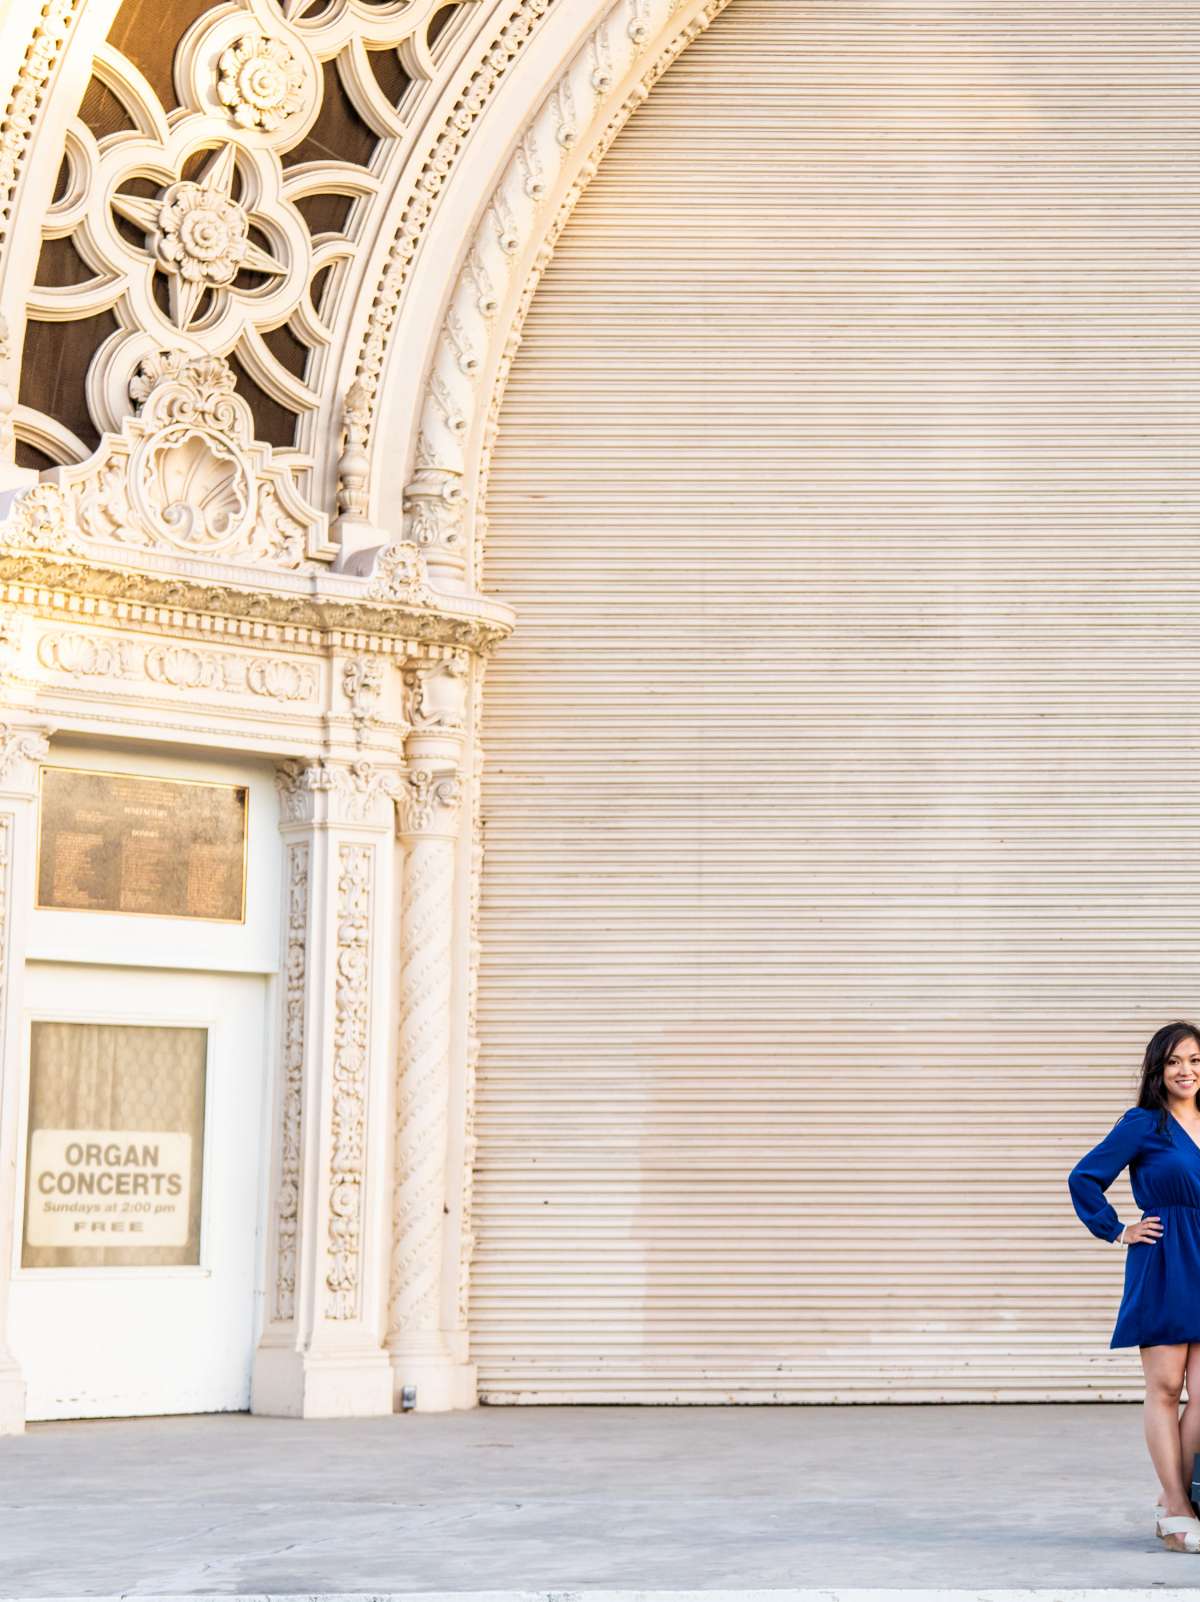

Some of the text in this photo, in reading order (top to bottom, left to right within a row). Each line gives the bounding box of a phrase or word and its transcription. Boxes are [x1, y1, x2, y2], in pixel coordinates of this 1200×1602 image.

[65, 1143, 160, 1168] ORGAN
[38, 1171, 182, 1196] CONCERTS
[43, 1200, 176, 1215] Sundays at 2:00 pm
[73, 1221, 145, 1233] FREE
